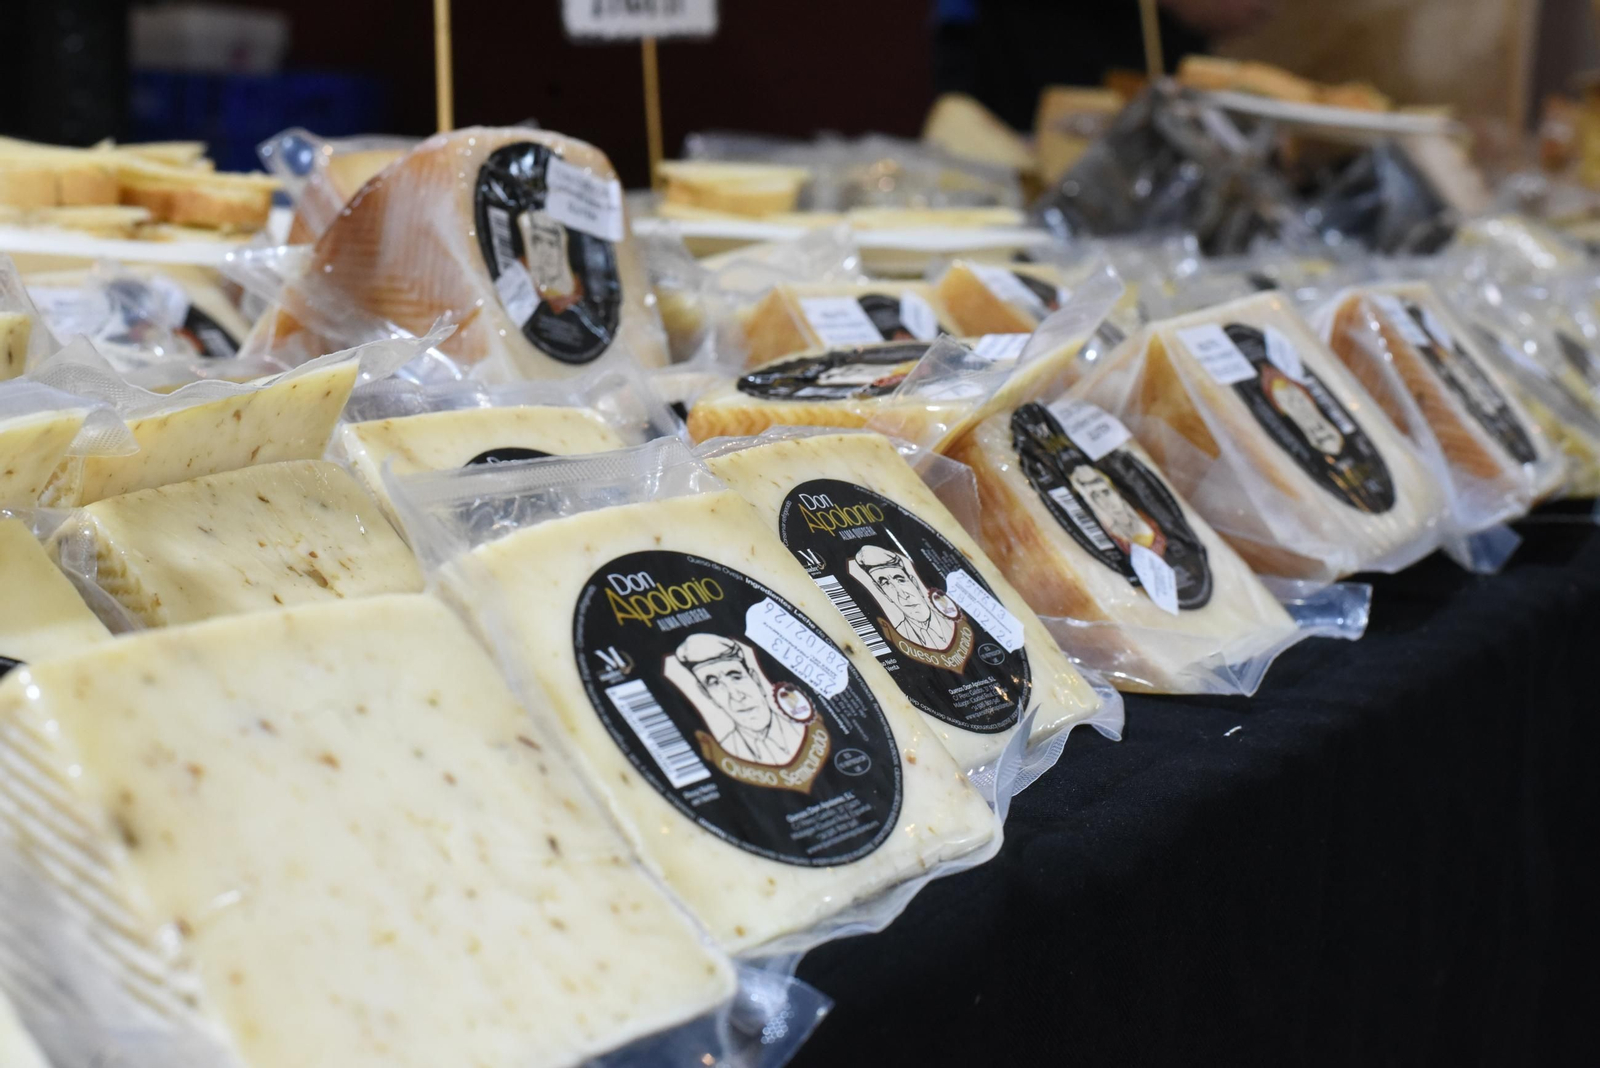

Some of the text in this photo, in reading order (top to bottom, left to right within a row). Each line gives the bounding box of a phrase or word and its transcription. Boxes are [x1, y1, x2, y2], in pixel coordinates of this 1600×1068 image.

[798, 493, 834, 511] Don
[798, 501, 884, 537] Apolonio
[838, 526, 878, 541] ALMA QUESERA
[604, 577, 724, 628] Apolonio
[607, 571, 656, 596] Don
[746, 577, 794, 612] Ingredientes:
[794, 609, 816, 630] Leche
[656, 614, 681, 632] ALMA
[764, 602, 848, 674] 28/02/26
[948, 586, 1013, 648] 28/02/26
[770, 636, 837, 695] 250613
[898, 626, 973, 668] Queso Semicurado
[722, 729, 828, 786] Queso Semicurado
